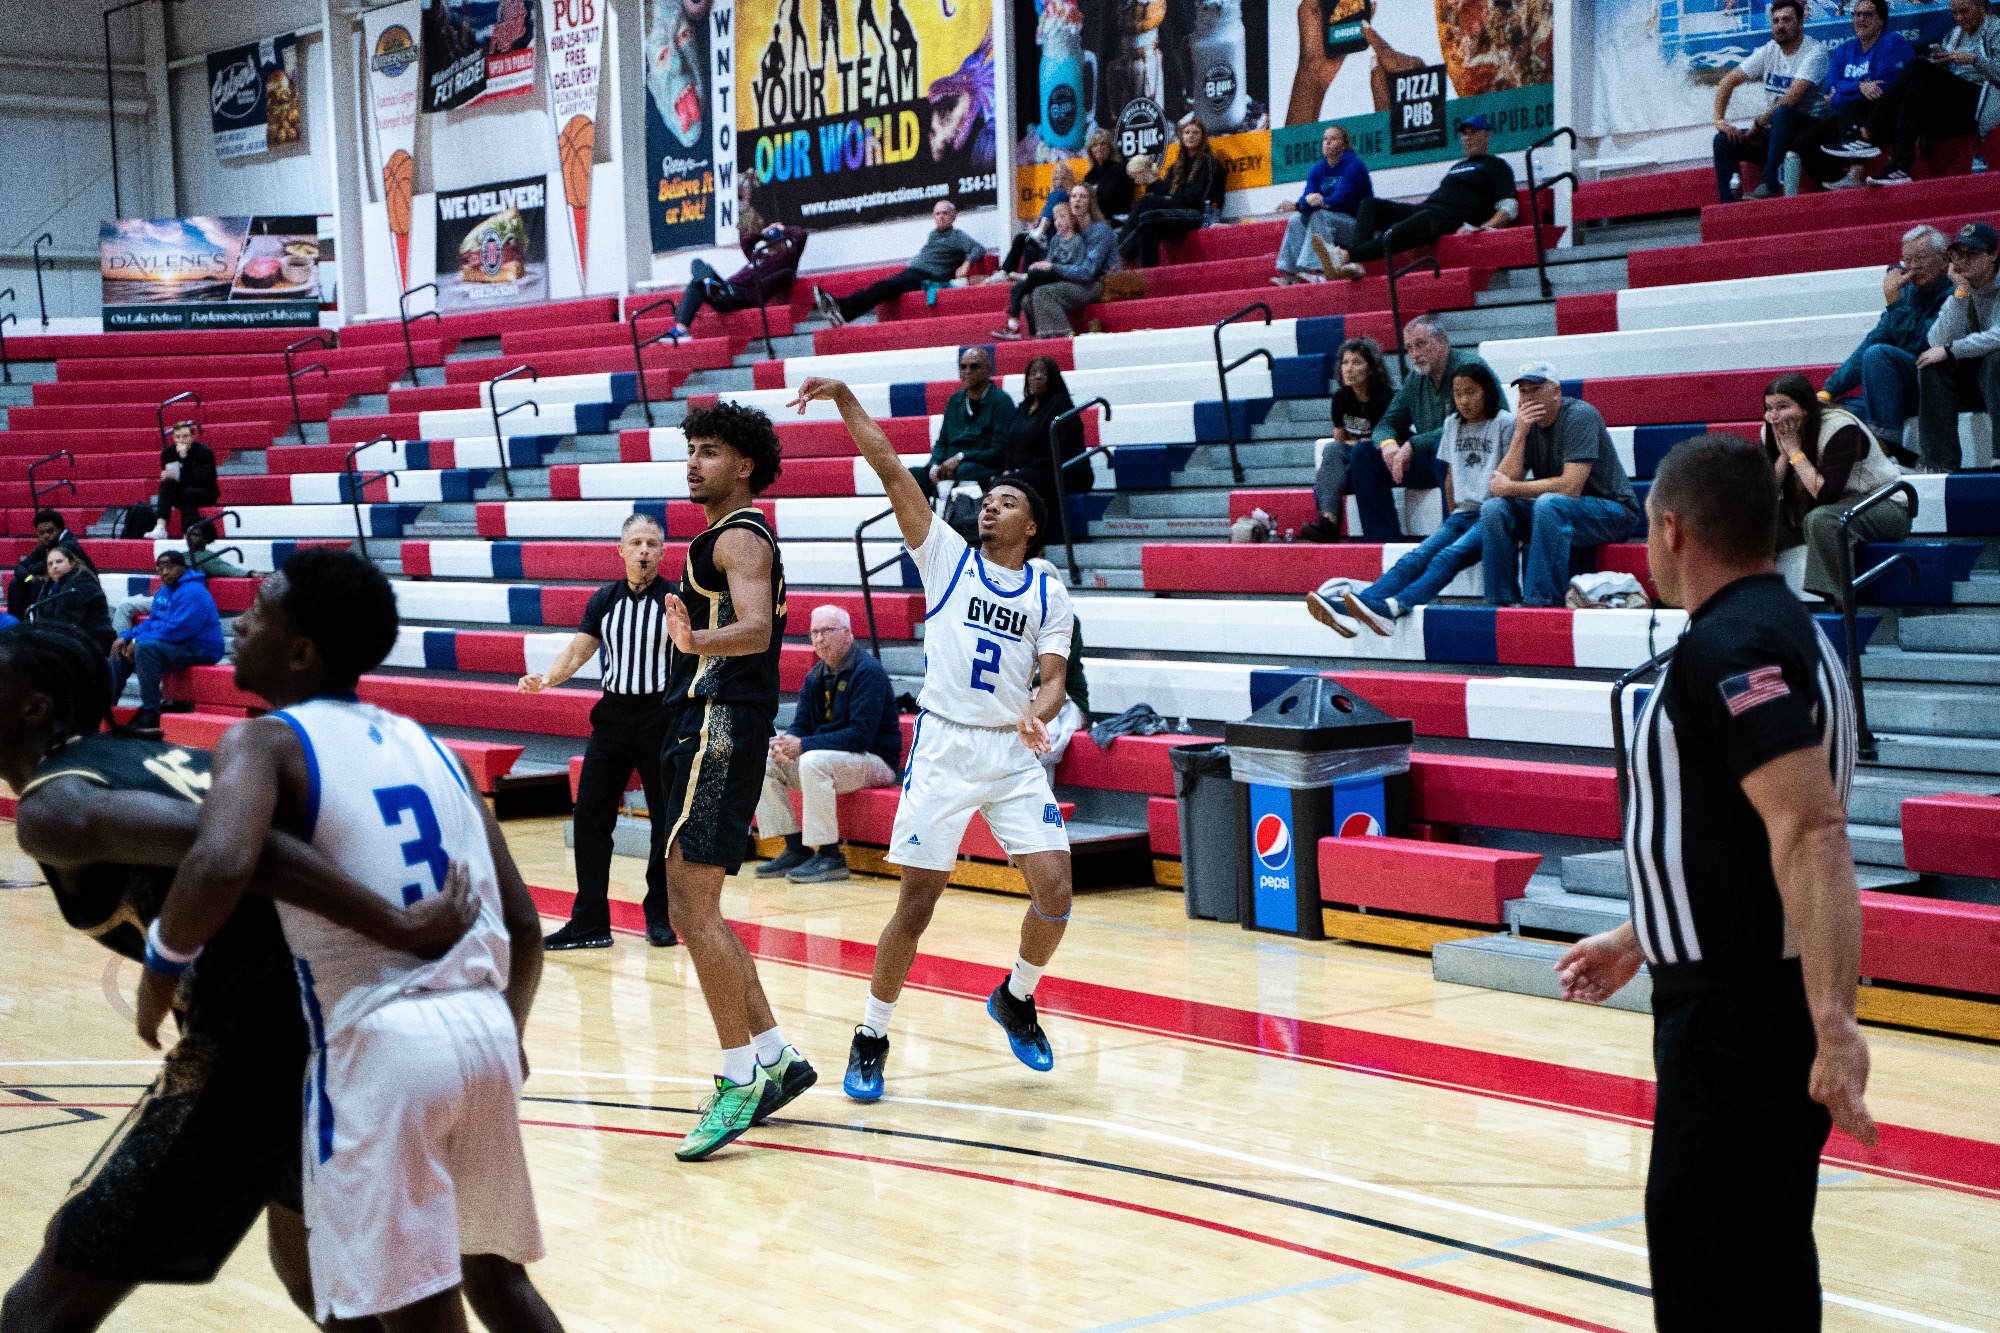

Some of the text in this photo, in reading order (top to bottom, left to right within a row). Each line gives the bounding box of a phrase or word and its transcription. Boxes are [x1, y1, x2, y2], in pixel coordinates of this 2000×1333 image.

[554, 0, 594, 31] PUB
[1333, 26, 1361, 39] ORDER
[565, 47, 586, 68] FREE
[433, 78, 454, 106] FLY
[455, 58, 486, 94] RIDE!
[555, 65, 598, 90] DELIVERY
[753, 44, 918, 127] YOUR TEAM
[1396, 72, 1439, 102] PIZZA
[1403, 101, 1433, 129] PUB
[755, 110, 920, 185] OUR WORLD
[1122, 128, 1159, 157] B-LUX
[1284, 142, 1320, 166] ORDE
[439, 183, 545, 220] WE DELIVER!
[658, 173, 700, 201] Believe
[666, 197, 708, 225] or Not!
[111, 311, 182, 325] On Lake Delton
[967, 597, 1027, 636] GVSU
[971, 638, 1001, 693] 2
[373, 784, 450, 908] 3
[1259, 875, 1290, 891] pepsi
